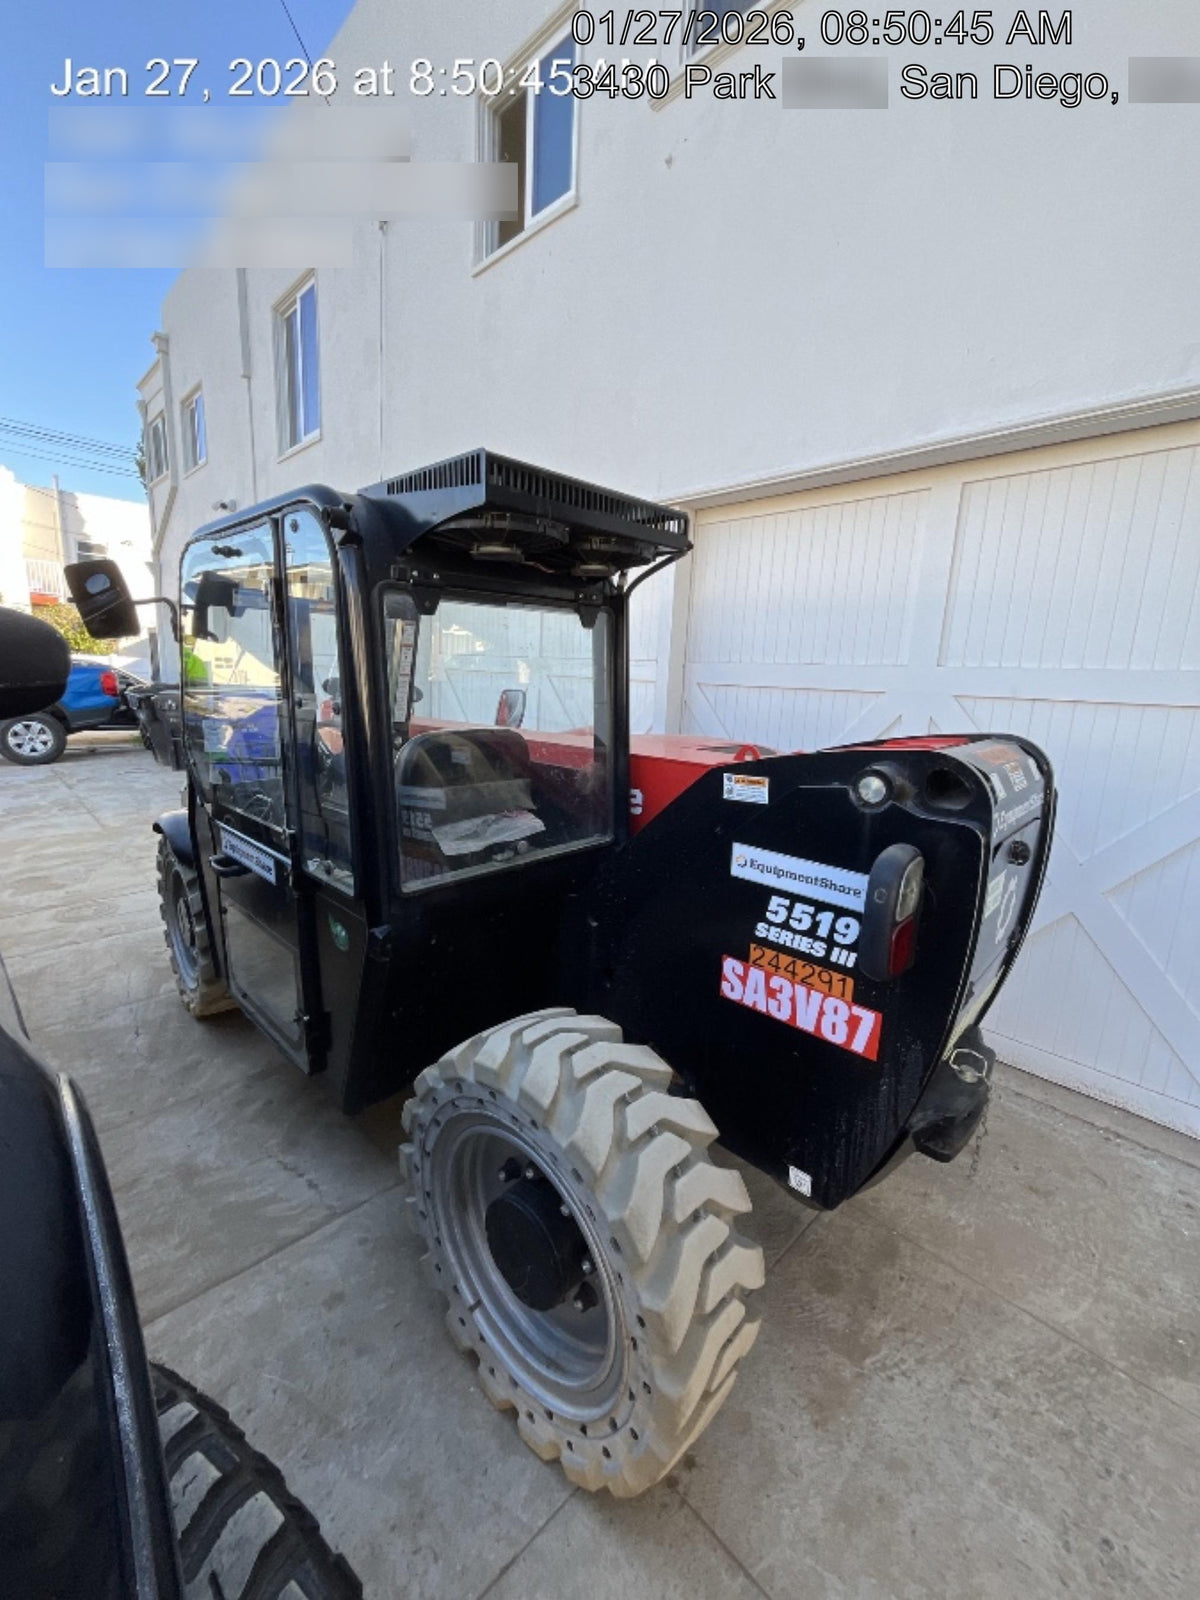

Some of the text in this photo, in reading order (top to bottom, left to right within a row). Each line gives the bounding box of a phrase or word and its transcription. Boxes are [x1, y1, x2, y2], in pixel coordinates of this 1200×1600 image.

[749, 857, 862, 898] EquipmentShare
[754, 922, 858, 968] SERIES III
[765, 895, 860, 945] 5519
[751, 945, 848, 998] 244291
[721, 957, 876, 1054] SA3V87
